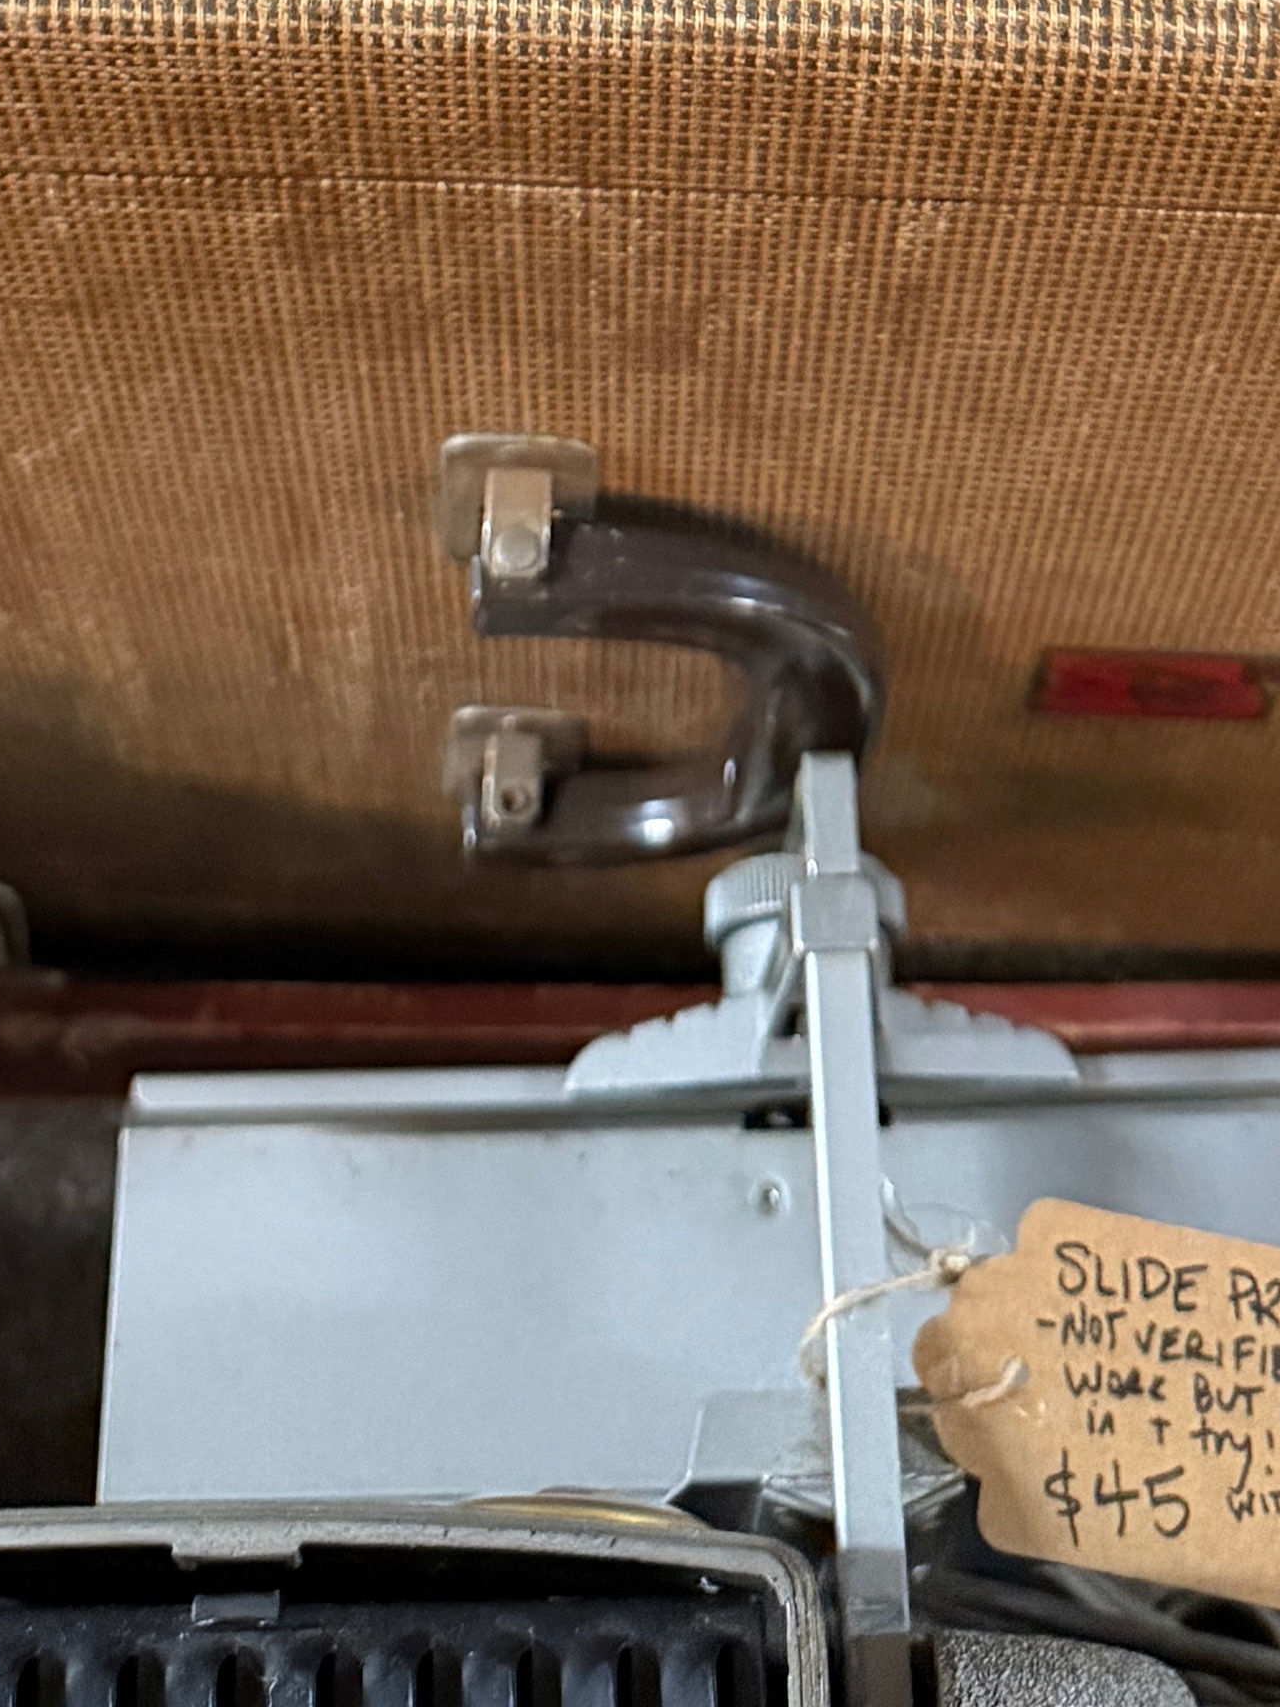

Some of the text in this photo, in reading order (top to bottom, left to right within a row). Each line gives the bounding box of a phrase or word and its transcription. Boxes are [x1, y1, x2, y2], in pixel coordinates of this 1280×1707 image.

[1055, 1241, 1208, 1312] SLIDE
[1087, 1400, 1114, 1435] in
[1193, 1373, 1264, 1416] BUT
[1043, 1447, 1190, 1548] $45
